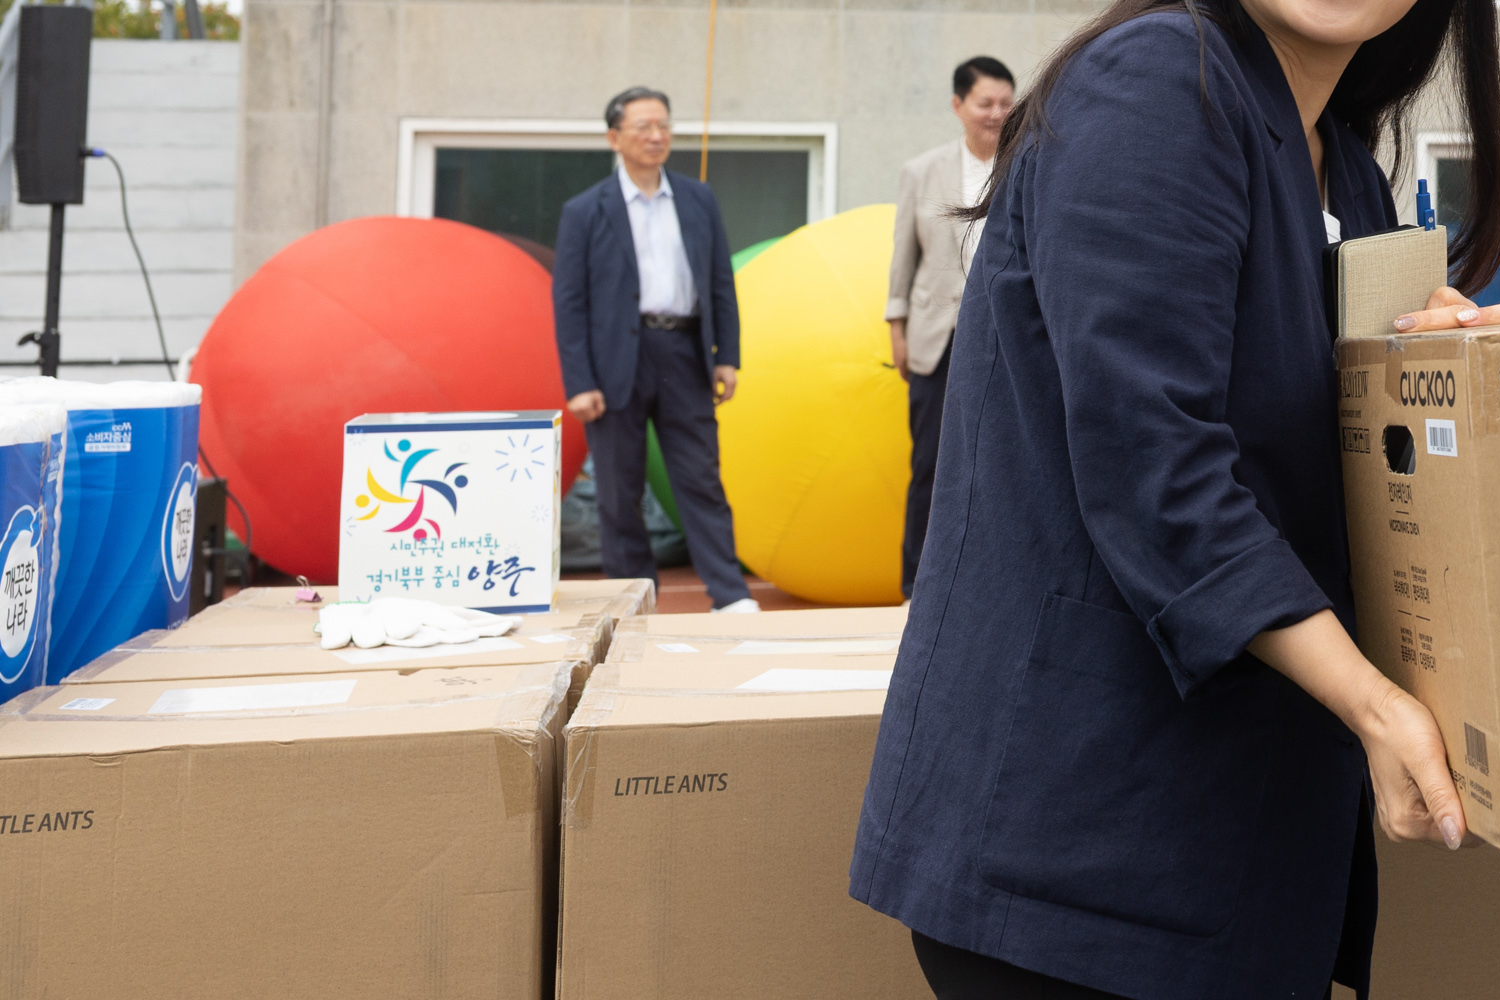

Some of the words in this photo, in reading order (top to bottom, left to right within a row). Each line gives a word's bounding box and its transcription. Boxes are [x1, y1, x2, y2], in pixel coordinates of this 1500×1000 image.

[1400, 369, 1456, 408] CUCKOO
[390, 537, 445, 558] 시민주권
[450, 533, 500, 556] 대전환
[4, 559, 35, 600] 깨끗한
[366, 565, 425, 593] 경기북부
[432, 565, 460, 589] 중심
[467, 556, 536, 597] 양주
[6, 599, 28, 636] 나라
[614, 775, 676, 797] LITTLE
[677, 772, 729, 793] ANTS
[37, 809, 95, 832] ANTS
